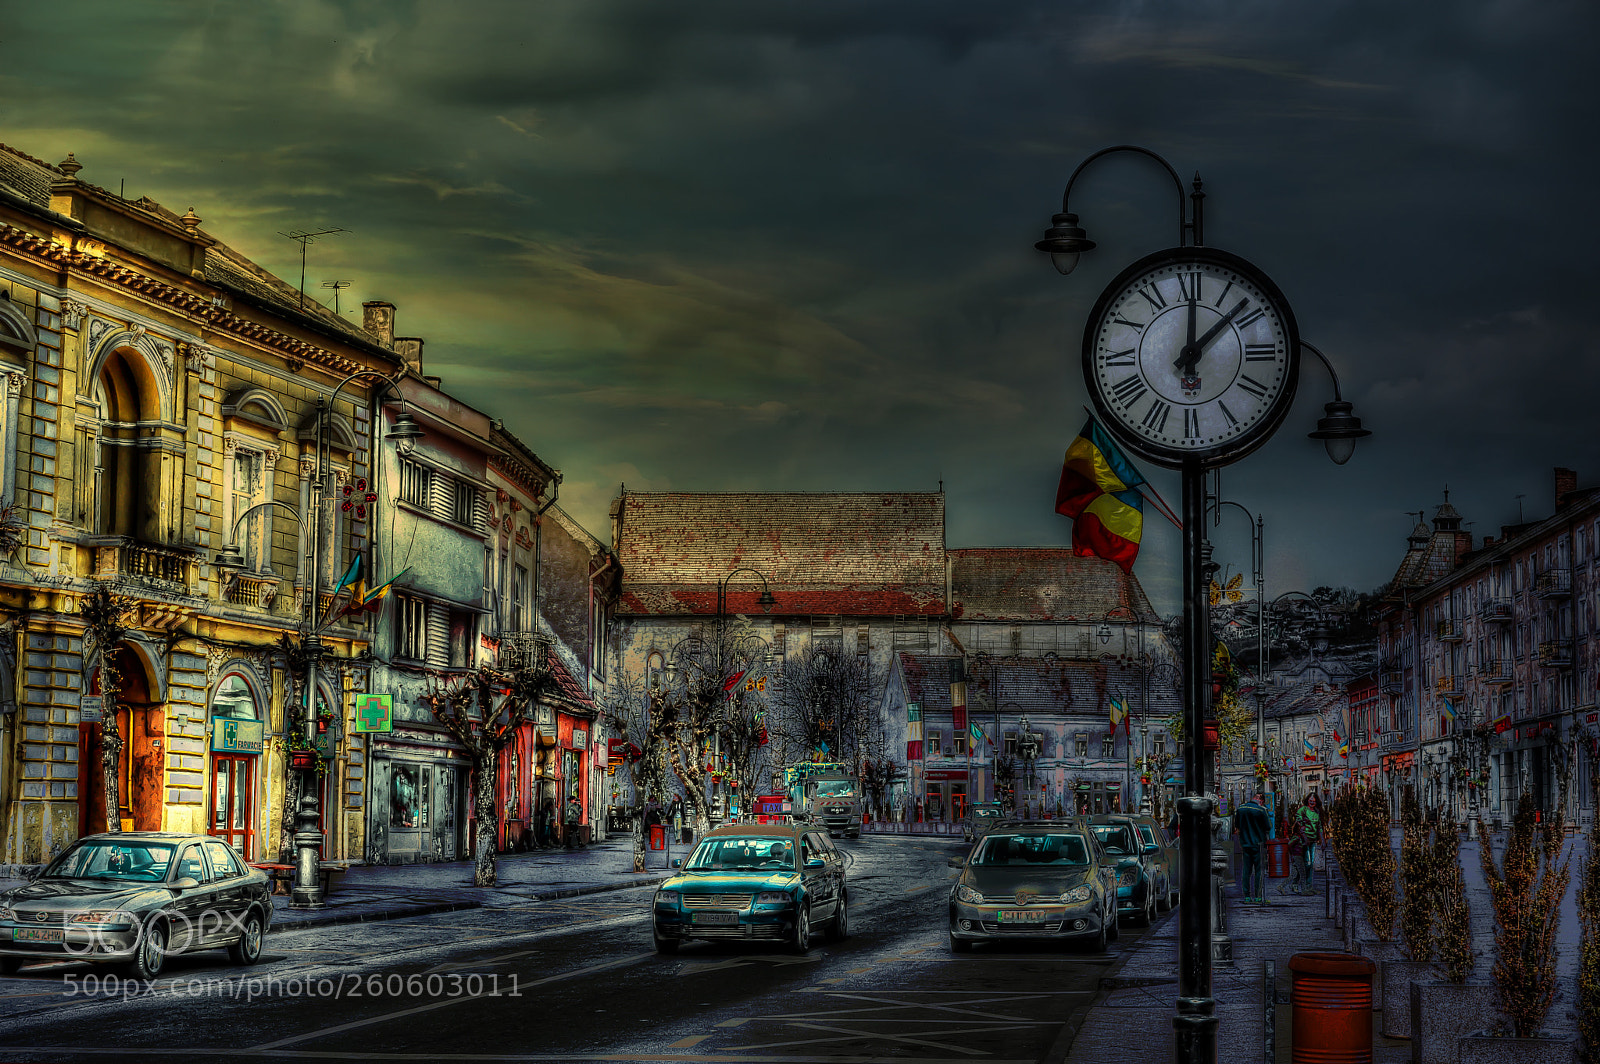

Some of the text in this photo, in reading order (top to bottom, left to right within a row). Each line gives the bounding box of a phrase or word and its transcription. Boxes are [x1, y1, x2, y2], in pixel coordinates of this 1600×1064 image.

[1137, 281, 1169, 315] XI
[1113, 311, 1145, 335] X
[1234, 306, 1265, 330] II
[1105, 348, 1136, 367] IX
[1245, 343, 1276, 362] III
[1112, 373, 1148, 410] VIII
[1236, 374, 1269, 402] IV
[1142, 399, 1171, 434] VII
[1184, 408, 1200, 438] VI
[1217, 400, 1240, 429] V
[238, 740, 262, 750] FARMACIE
[764, 803, 782, 813] TAXI
